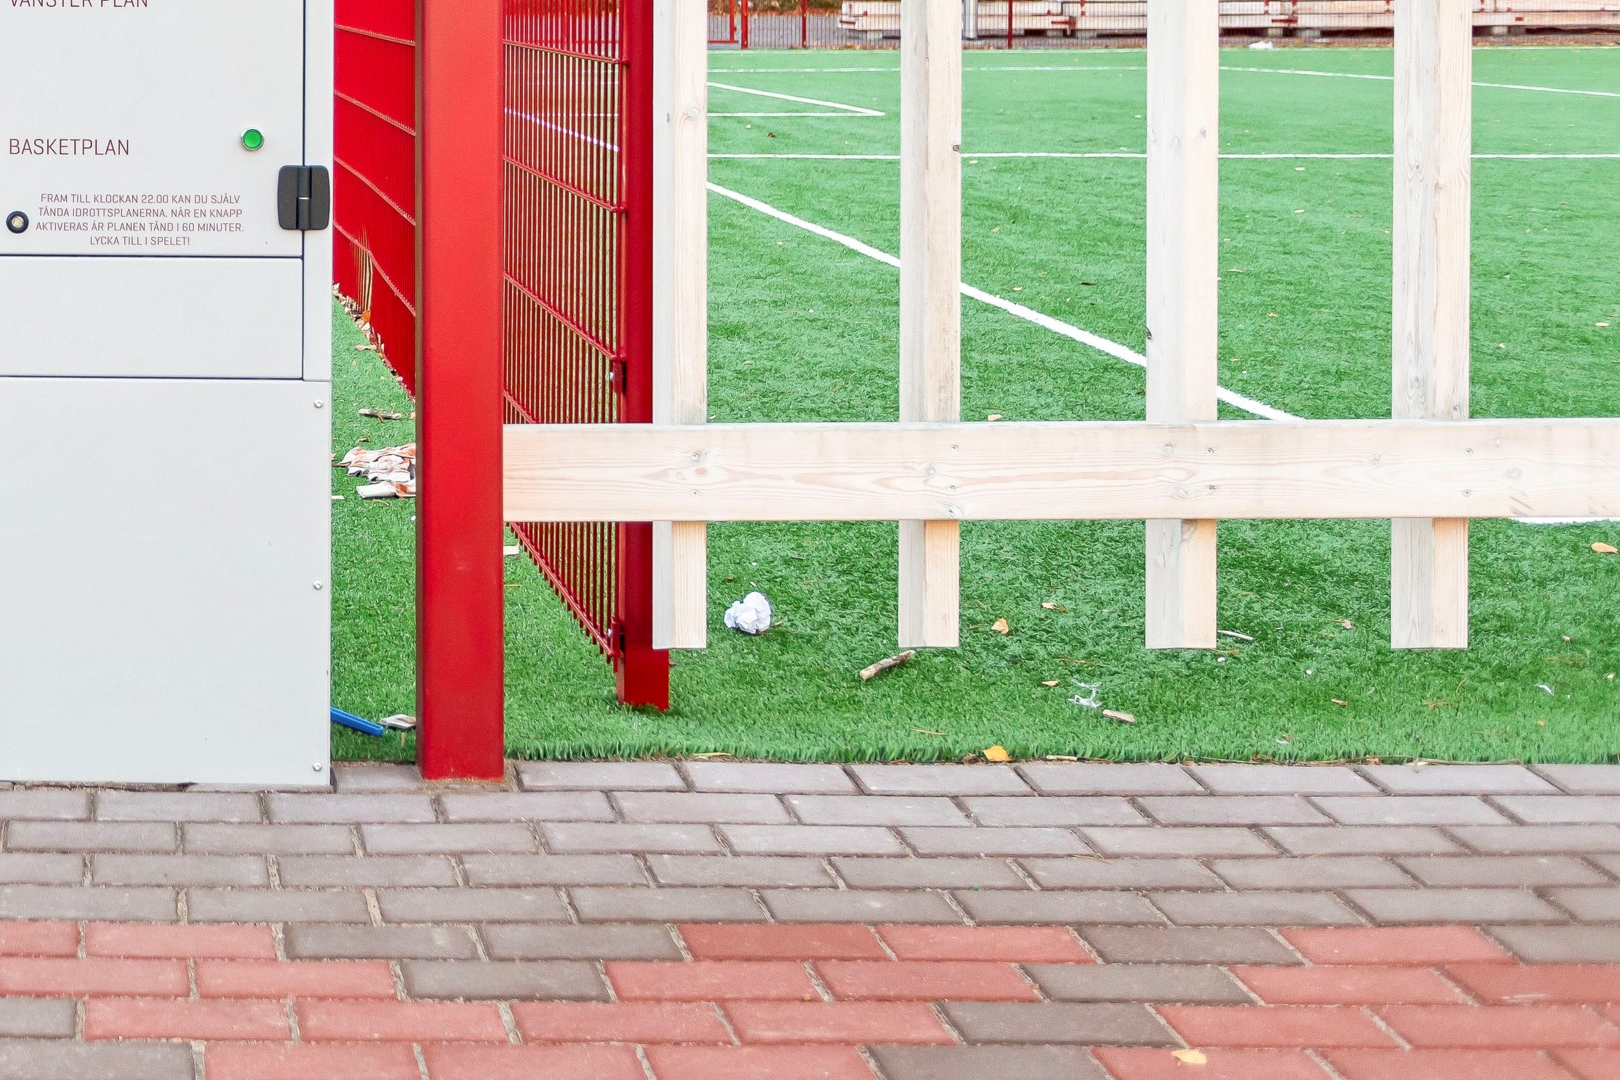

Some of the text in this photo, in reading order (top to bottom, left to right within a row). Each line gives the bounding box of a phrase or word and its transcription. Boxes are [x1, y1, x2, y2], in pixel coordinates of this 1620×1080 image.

[9, 138, 130, 156] BASKETPLAN
[41, 193, 241, 205] FRAM TILL KLOCKAN 22.00 KAN DU SJÄLV
[39, 206, 243, 219] TÄNDA IDROTTSPLANERNA. NÄR EN KNAPP
[36, 221, 89, 232] AKTIVERAS
[91, 219, 105, 232] ÄR
[108, 221, 146, 232] PLANEN
[149, 220, 174, 232] TÄND
[182, 222, 195, 232] 60
[198, 222, 245, 233] MINUTER.
[90, 235, 120, 246] LYCKA
[122, 235, 143, 246] TILL
[151, 236, 190, 246] SPELET!
